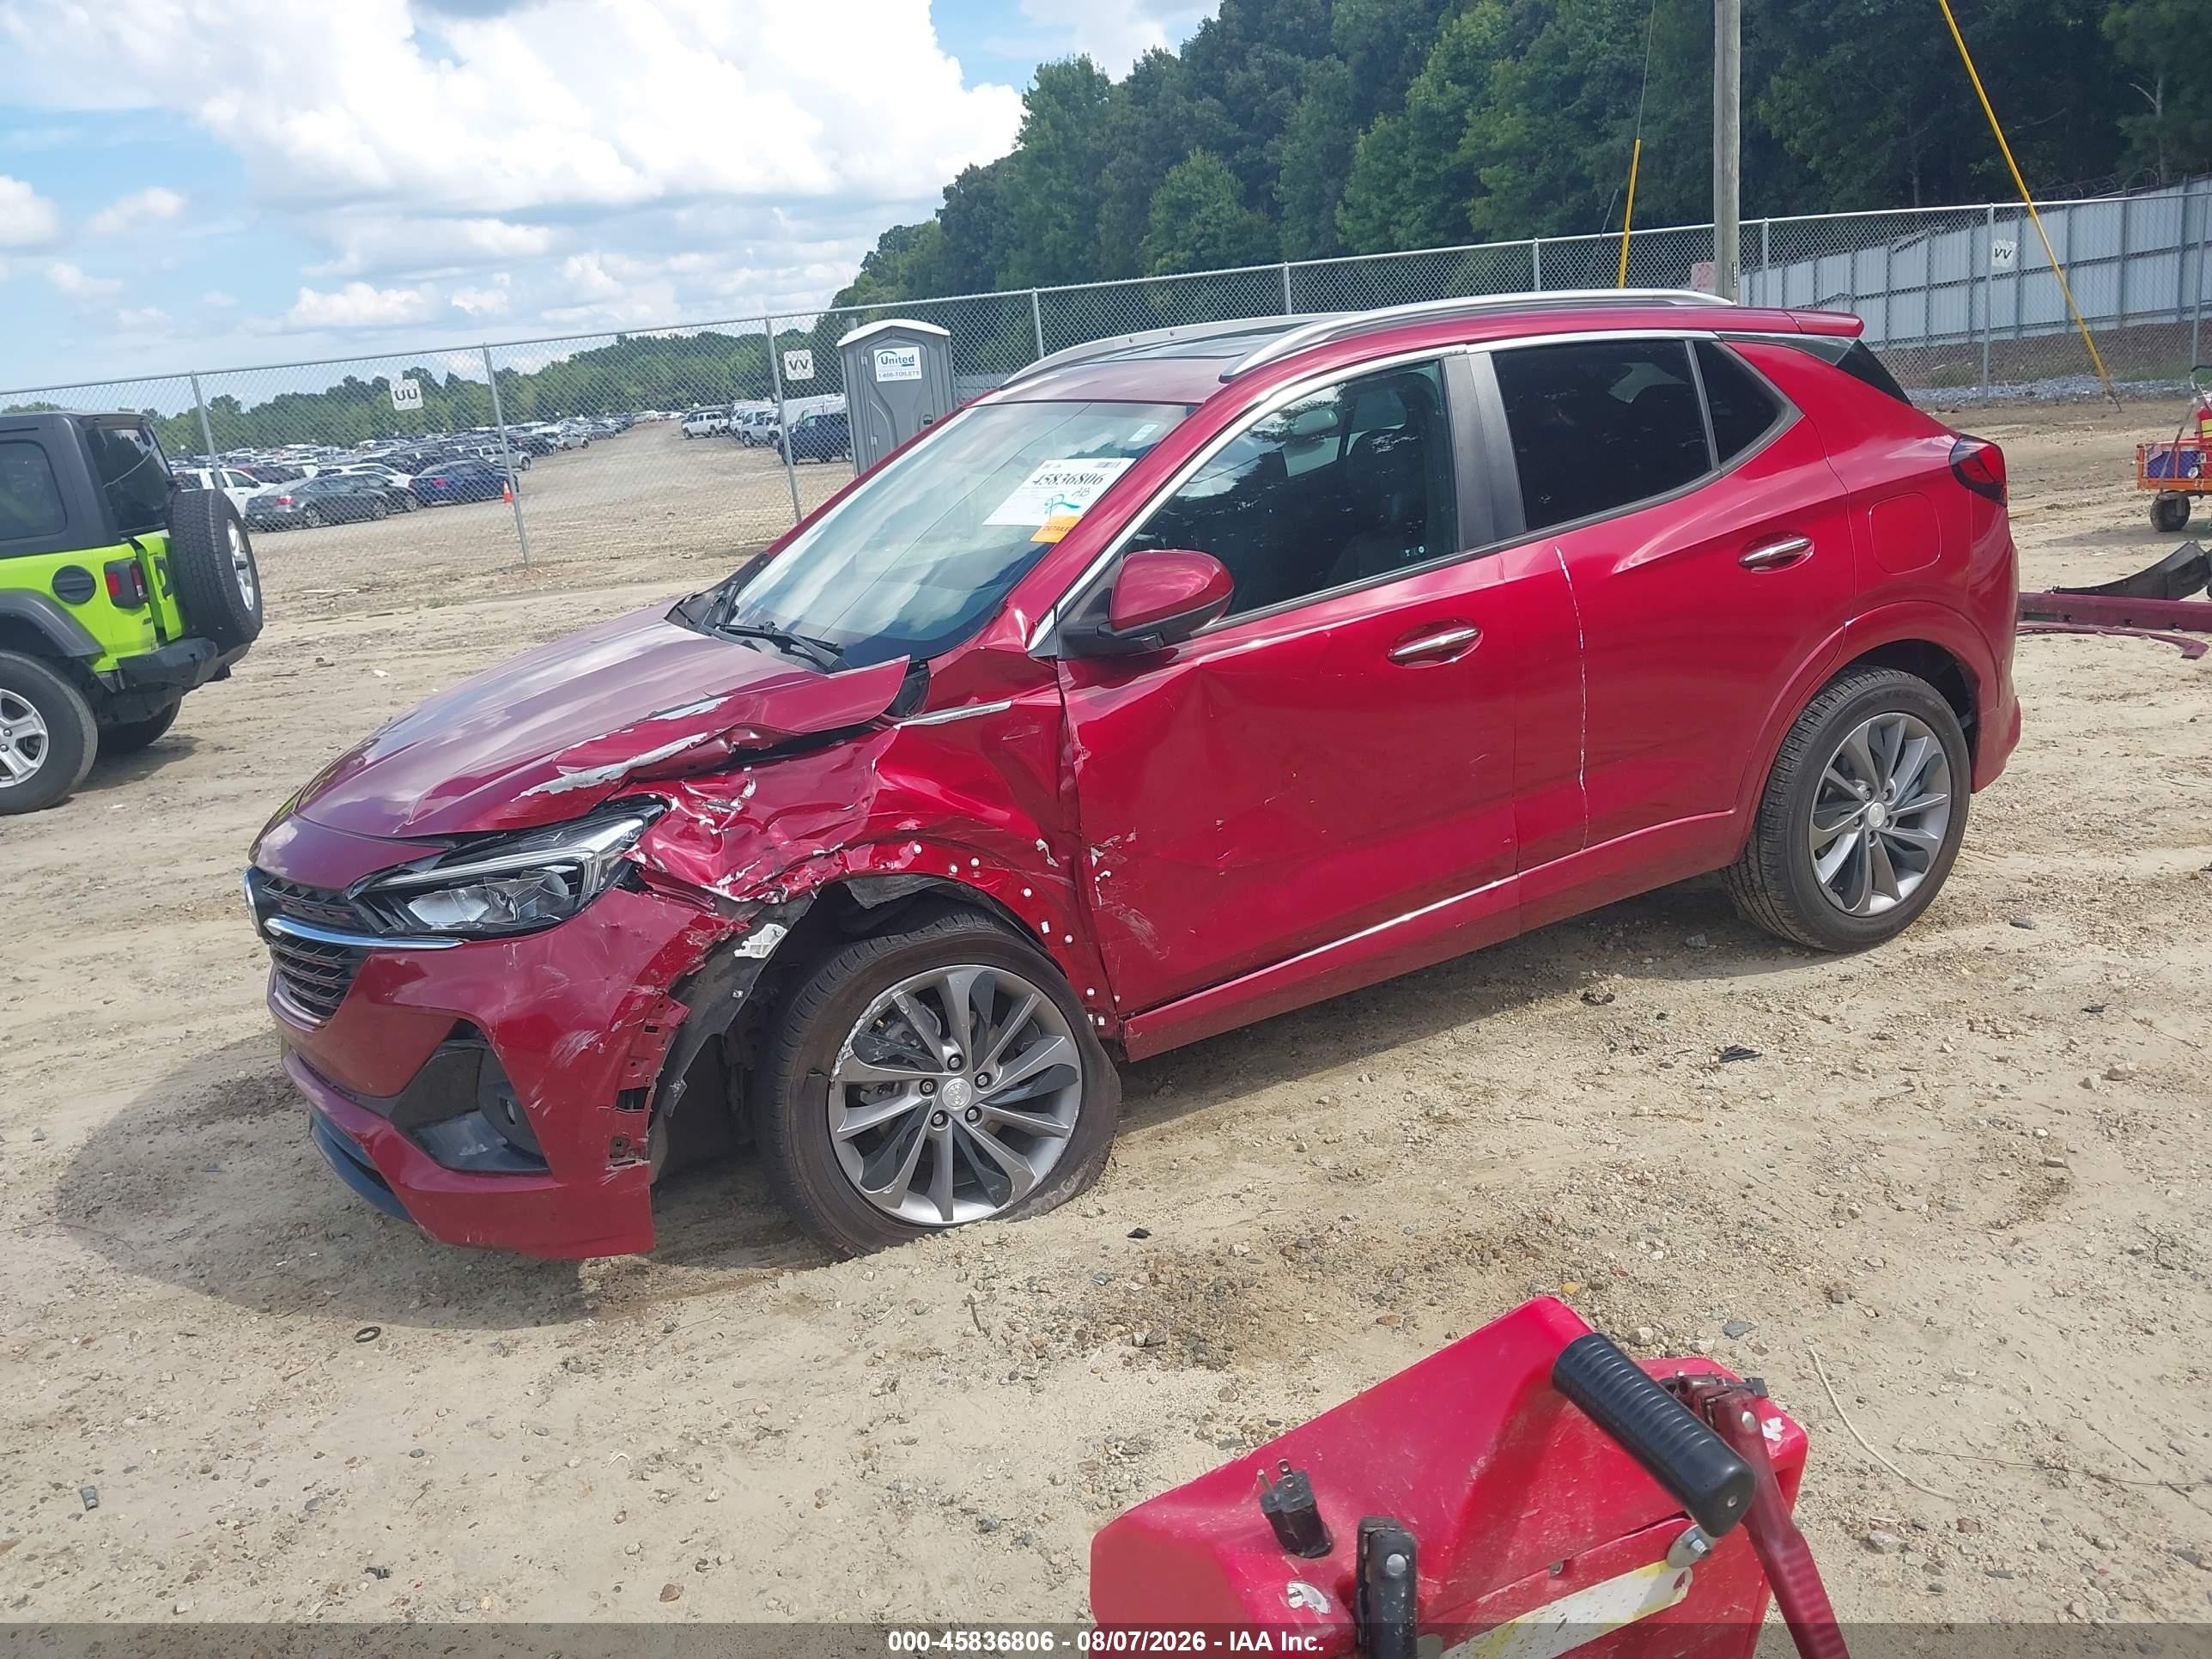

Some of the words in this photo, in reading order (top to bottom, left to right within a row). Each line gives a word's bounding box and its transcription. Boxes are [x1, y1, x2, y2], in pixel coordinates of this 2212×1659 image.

[880, 354, 915, 365] United
[394, 388, 417, 401] UU
[1032, 472, 1106, 485] 45836806
